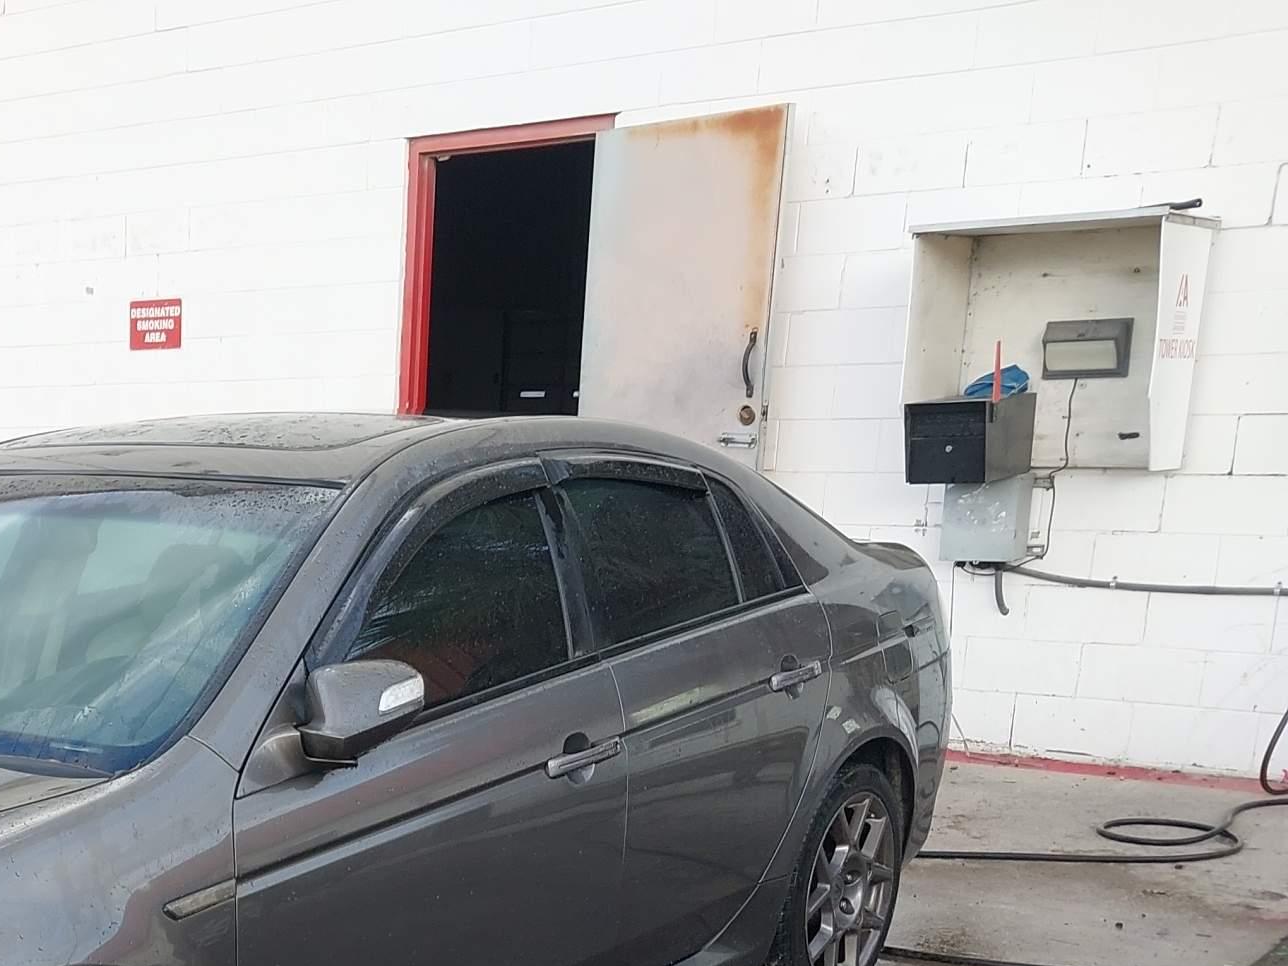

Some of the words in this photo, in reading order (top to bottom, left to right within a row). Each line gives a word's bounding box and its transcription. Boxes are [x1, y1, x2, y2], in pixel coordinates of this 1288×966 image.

[130, 305, 180, 319] DESIGNATED
[136, 319, 175, 331] SMOKING
[144, 331, 167, 343] AREA
